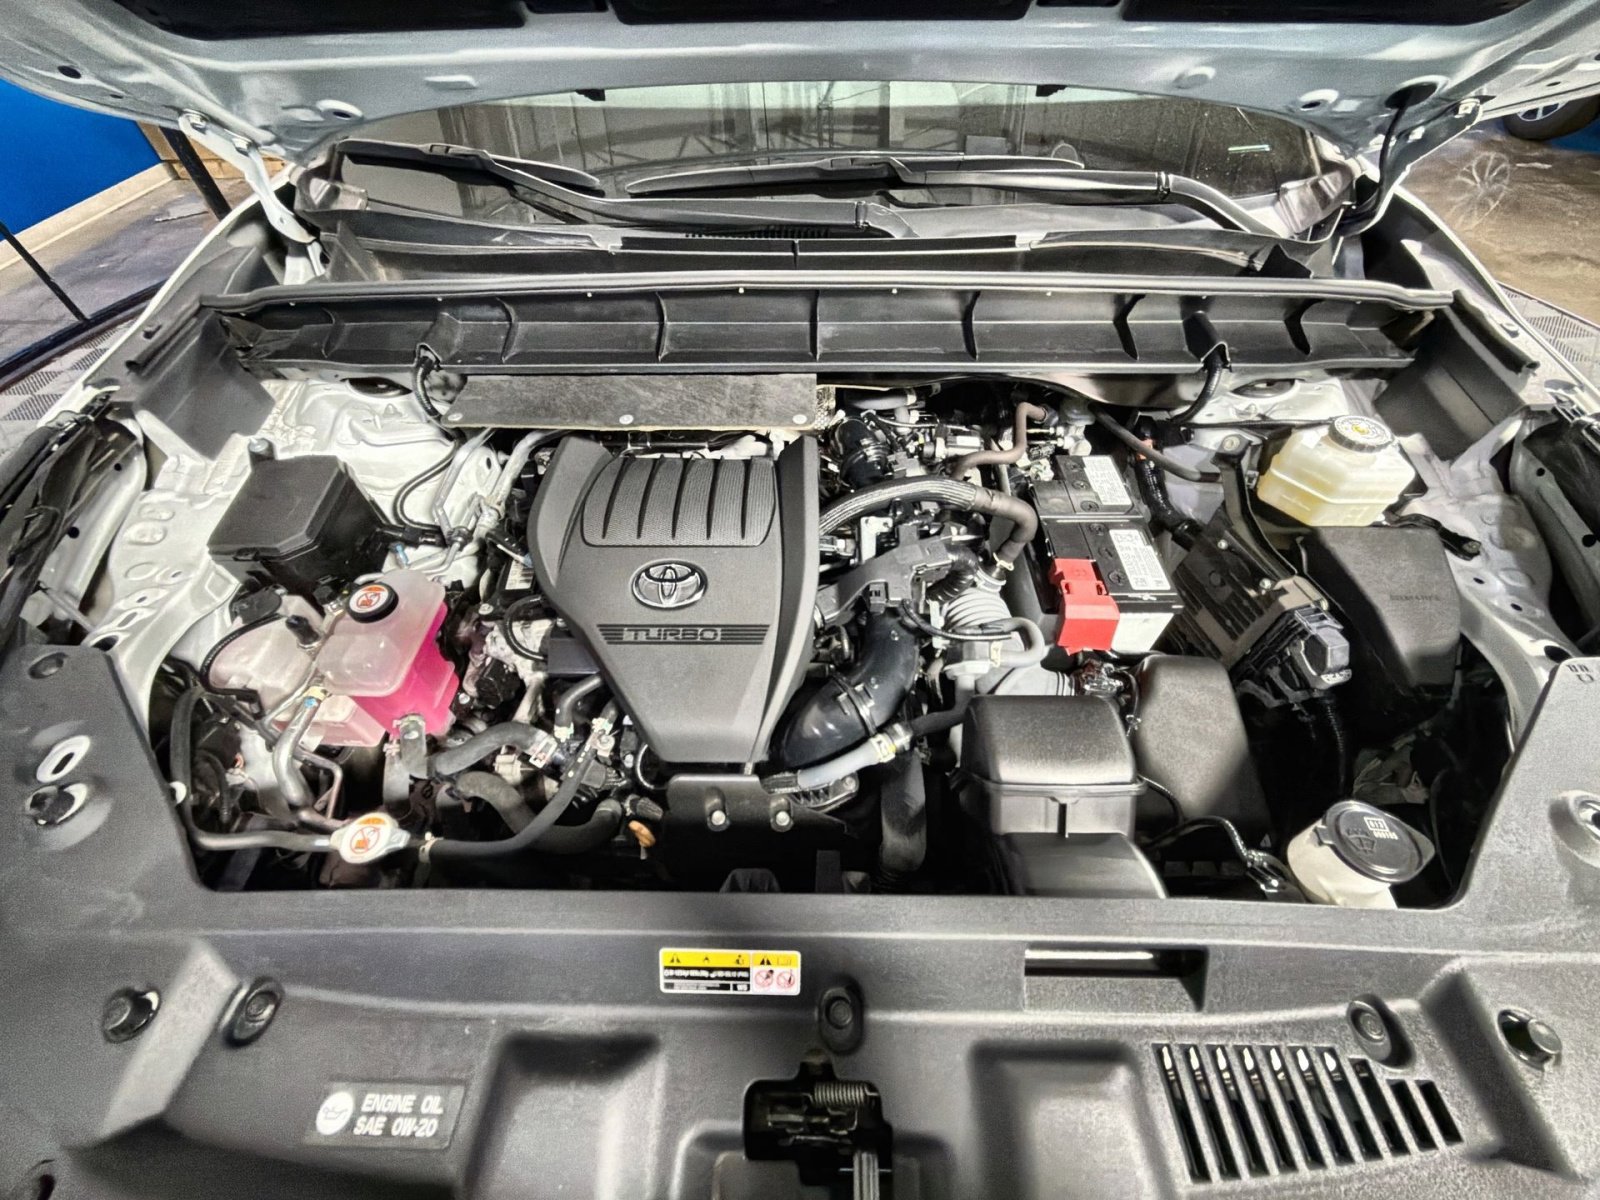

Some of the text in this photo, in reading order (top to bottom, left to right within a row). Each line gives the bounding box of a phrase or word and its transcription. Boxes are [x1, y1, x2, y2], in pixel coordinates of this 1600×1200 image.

[626, 628, 719, 641] TURBO
[361, 1093, 444, 1115] ENGINE OIL
[353, 1115, 439, 1138] SAE 0W-20
